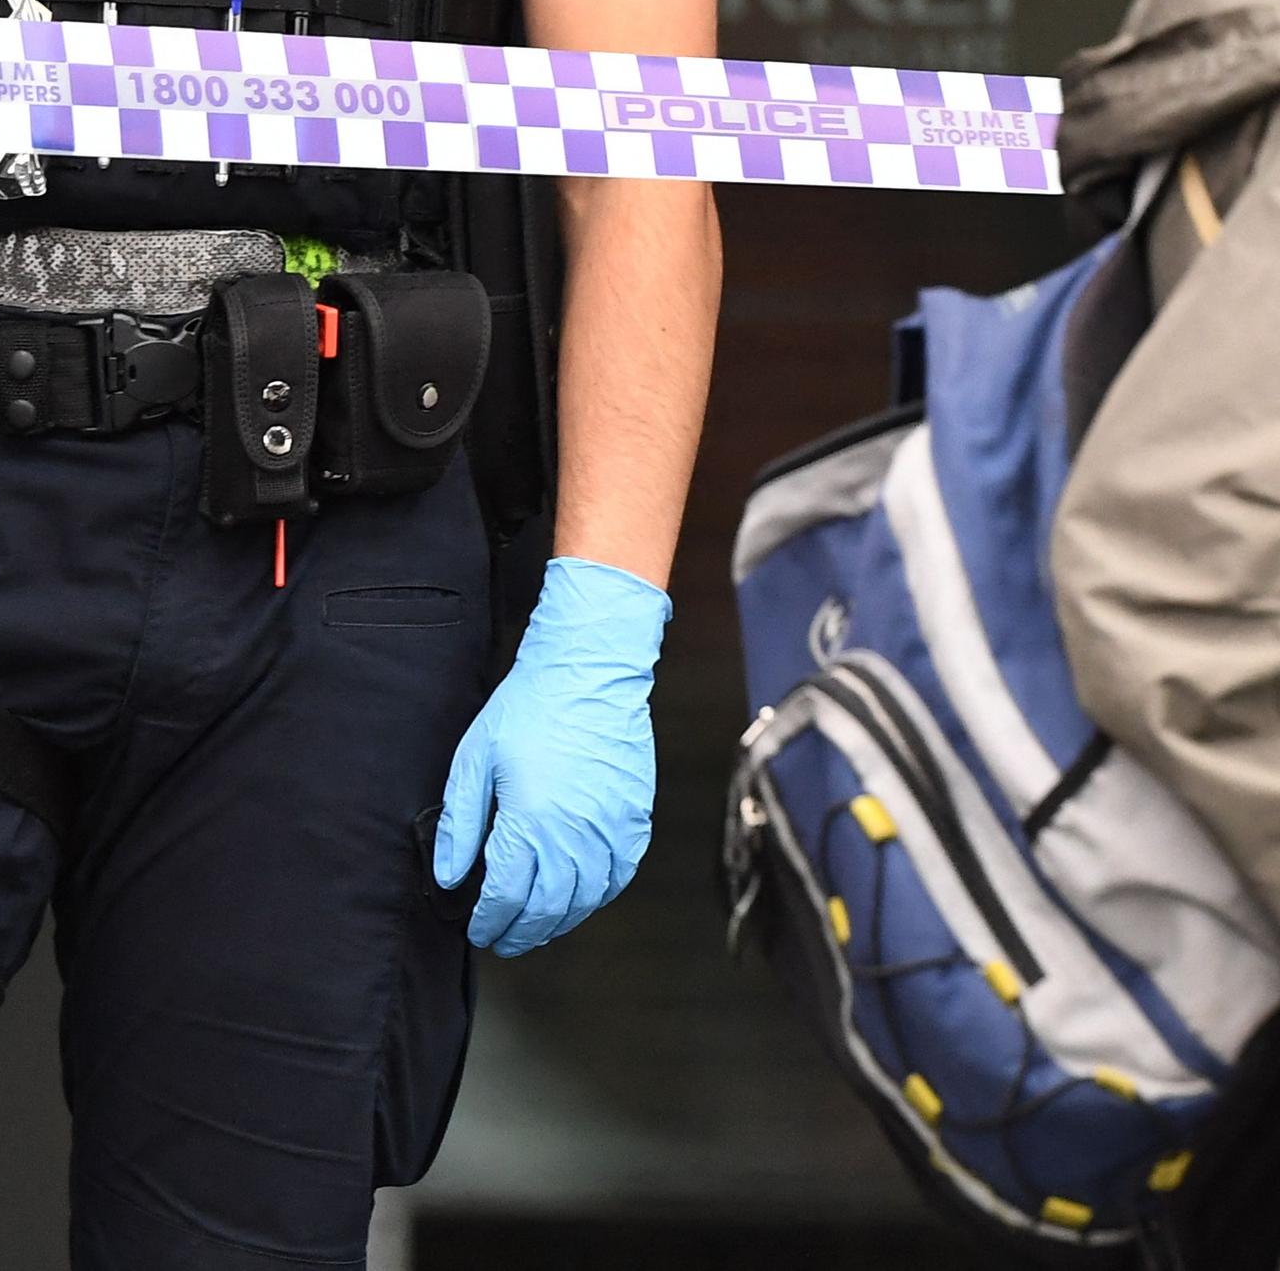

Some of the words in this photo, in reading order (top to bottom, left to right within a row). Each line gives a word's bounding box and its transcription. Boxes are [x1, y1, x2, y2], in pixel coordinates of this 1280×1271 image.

[128, 72, 229, 107] 1800
[243, 77, 321, 111] 333
[334, 82, 411, 116] 000
[615, 95, 850, 136] POLICE
[917, 108, 1027, 130] CRIME
[922, 128, 1031, 148] STOPPERS
